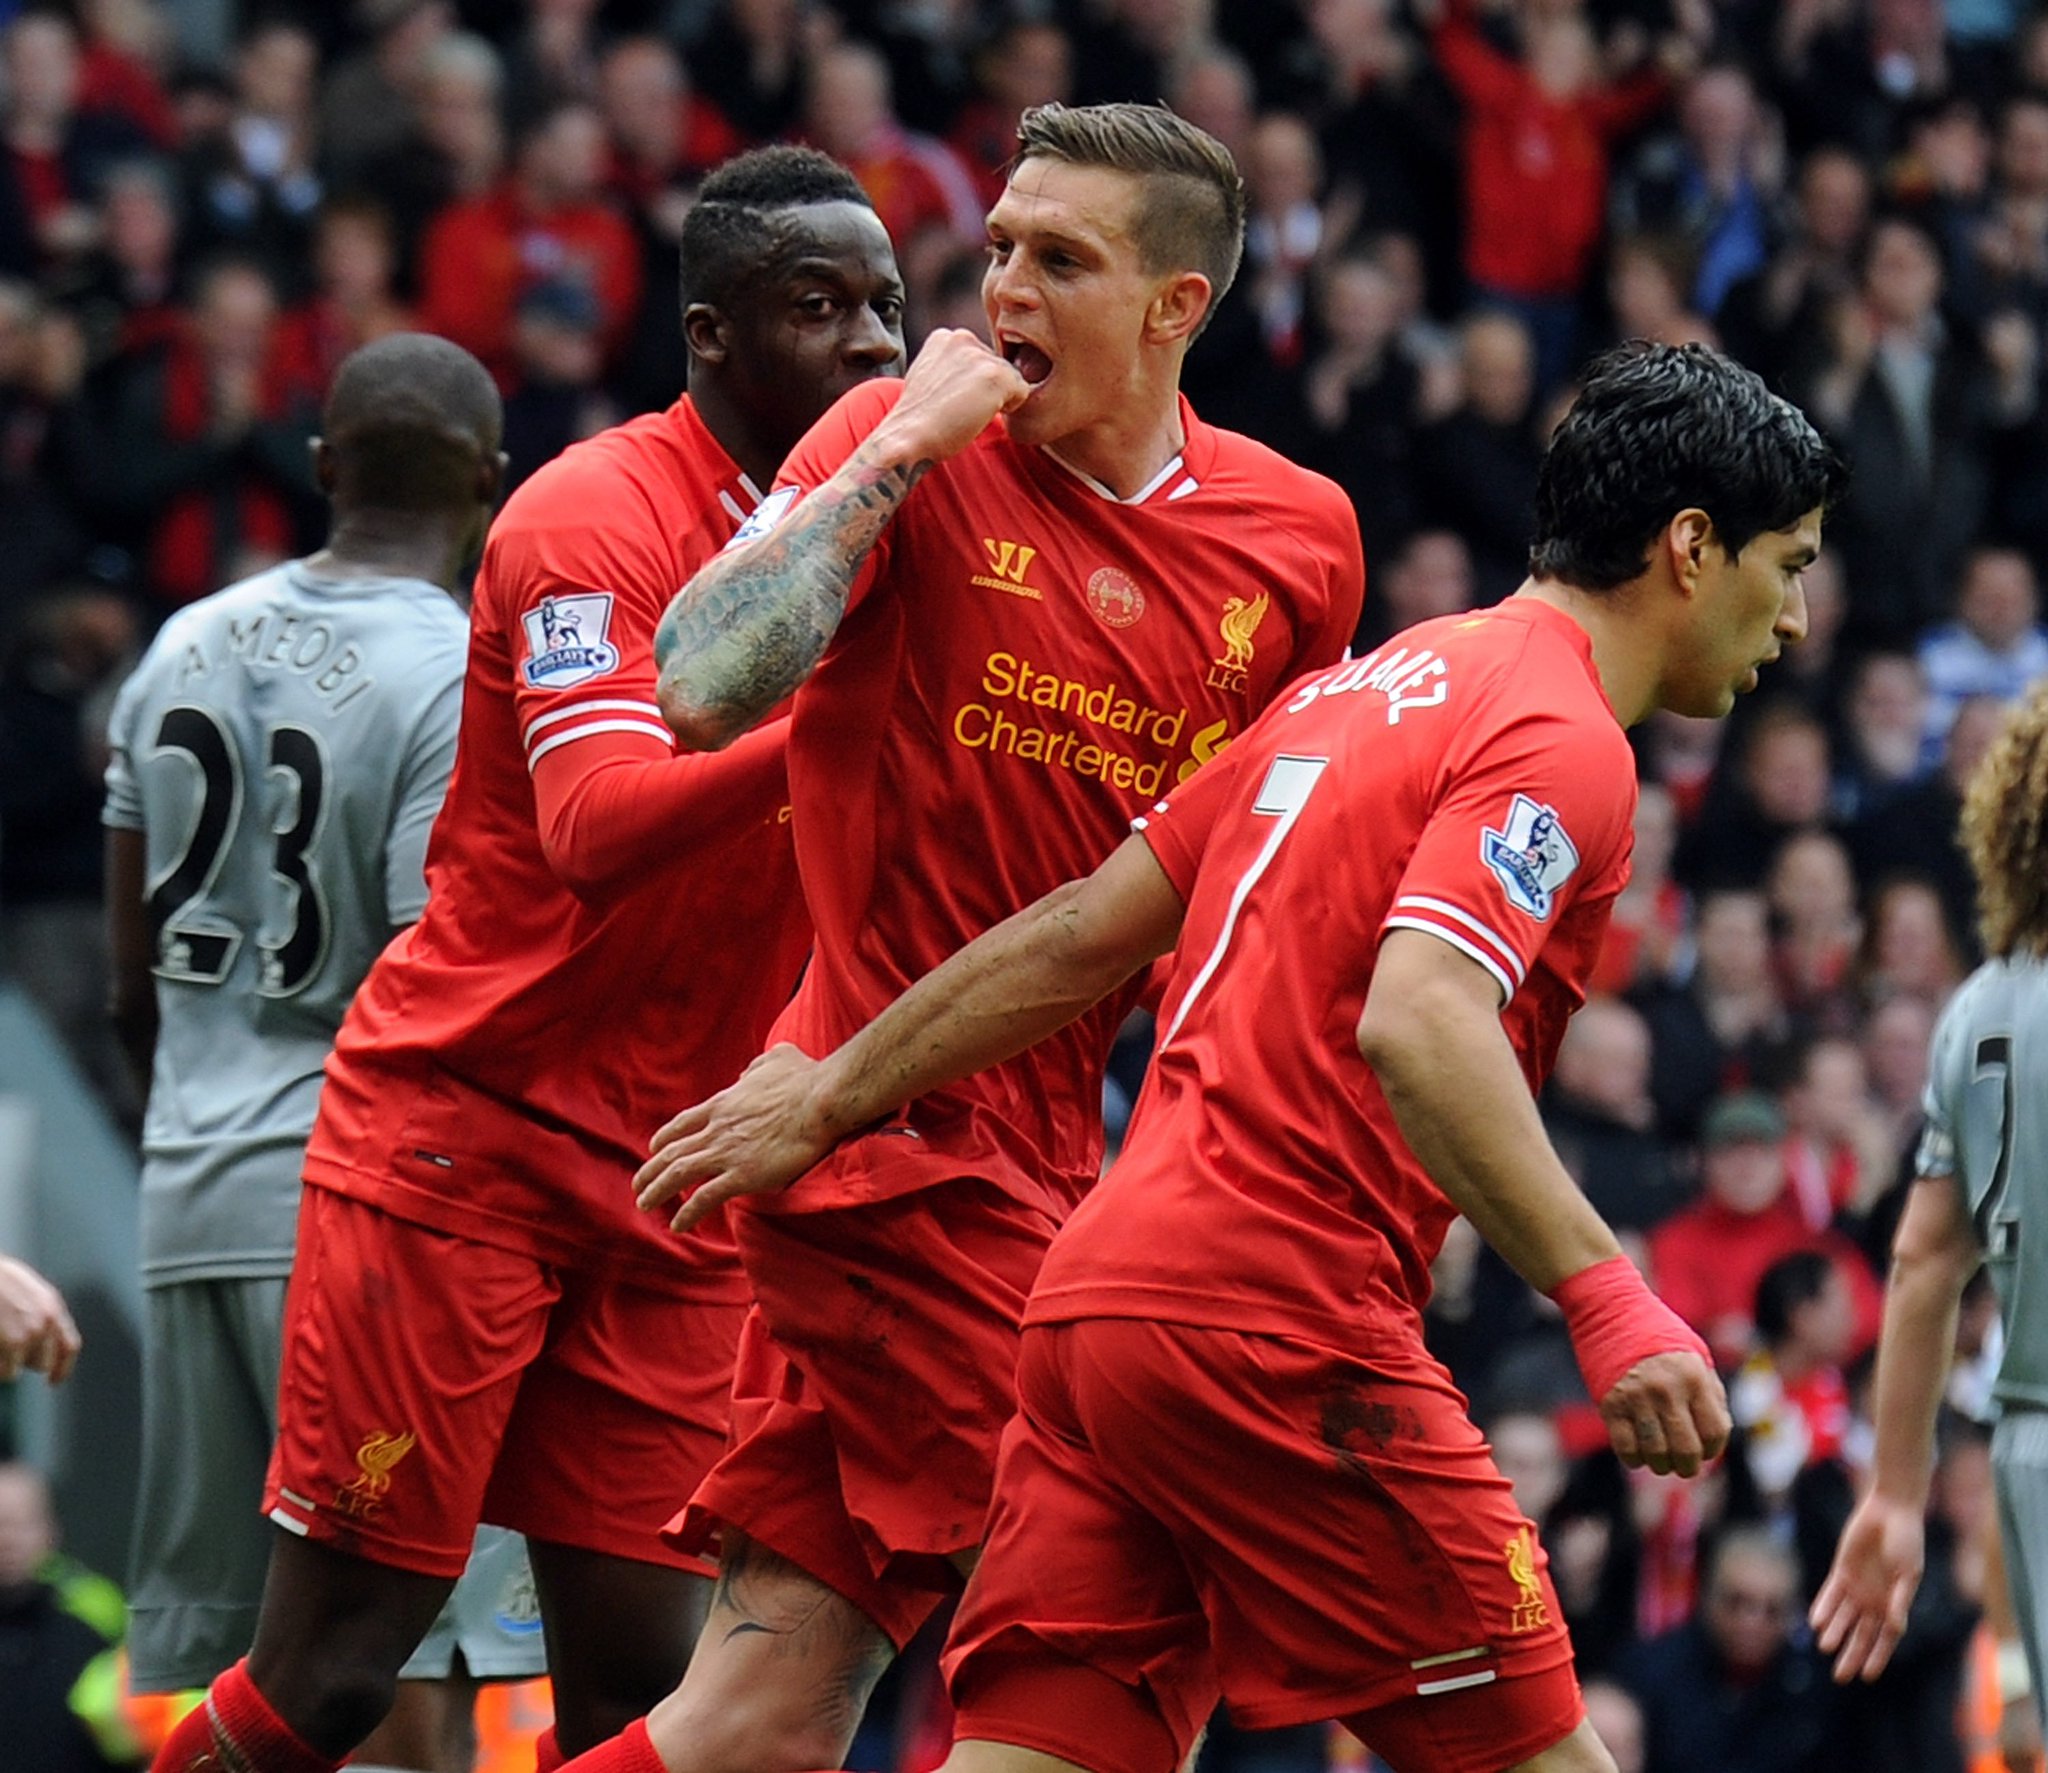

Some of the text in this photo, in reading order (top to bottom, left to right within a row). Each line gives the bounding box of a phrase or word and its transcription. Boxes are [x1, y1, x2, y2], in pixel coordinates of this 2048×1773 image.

[953, 703, 1168, 797] Chartered
[982, 652, 1187, 747] Standard
[144, 705, 333, 998] 23
[1160, 754, 1330, 1053] 7
